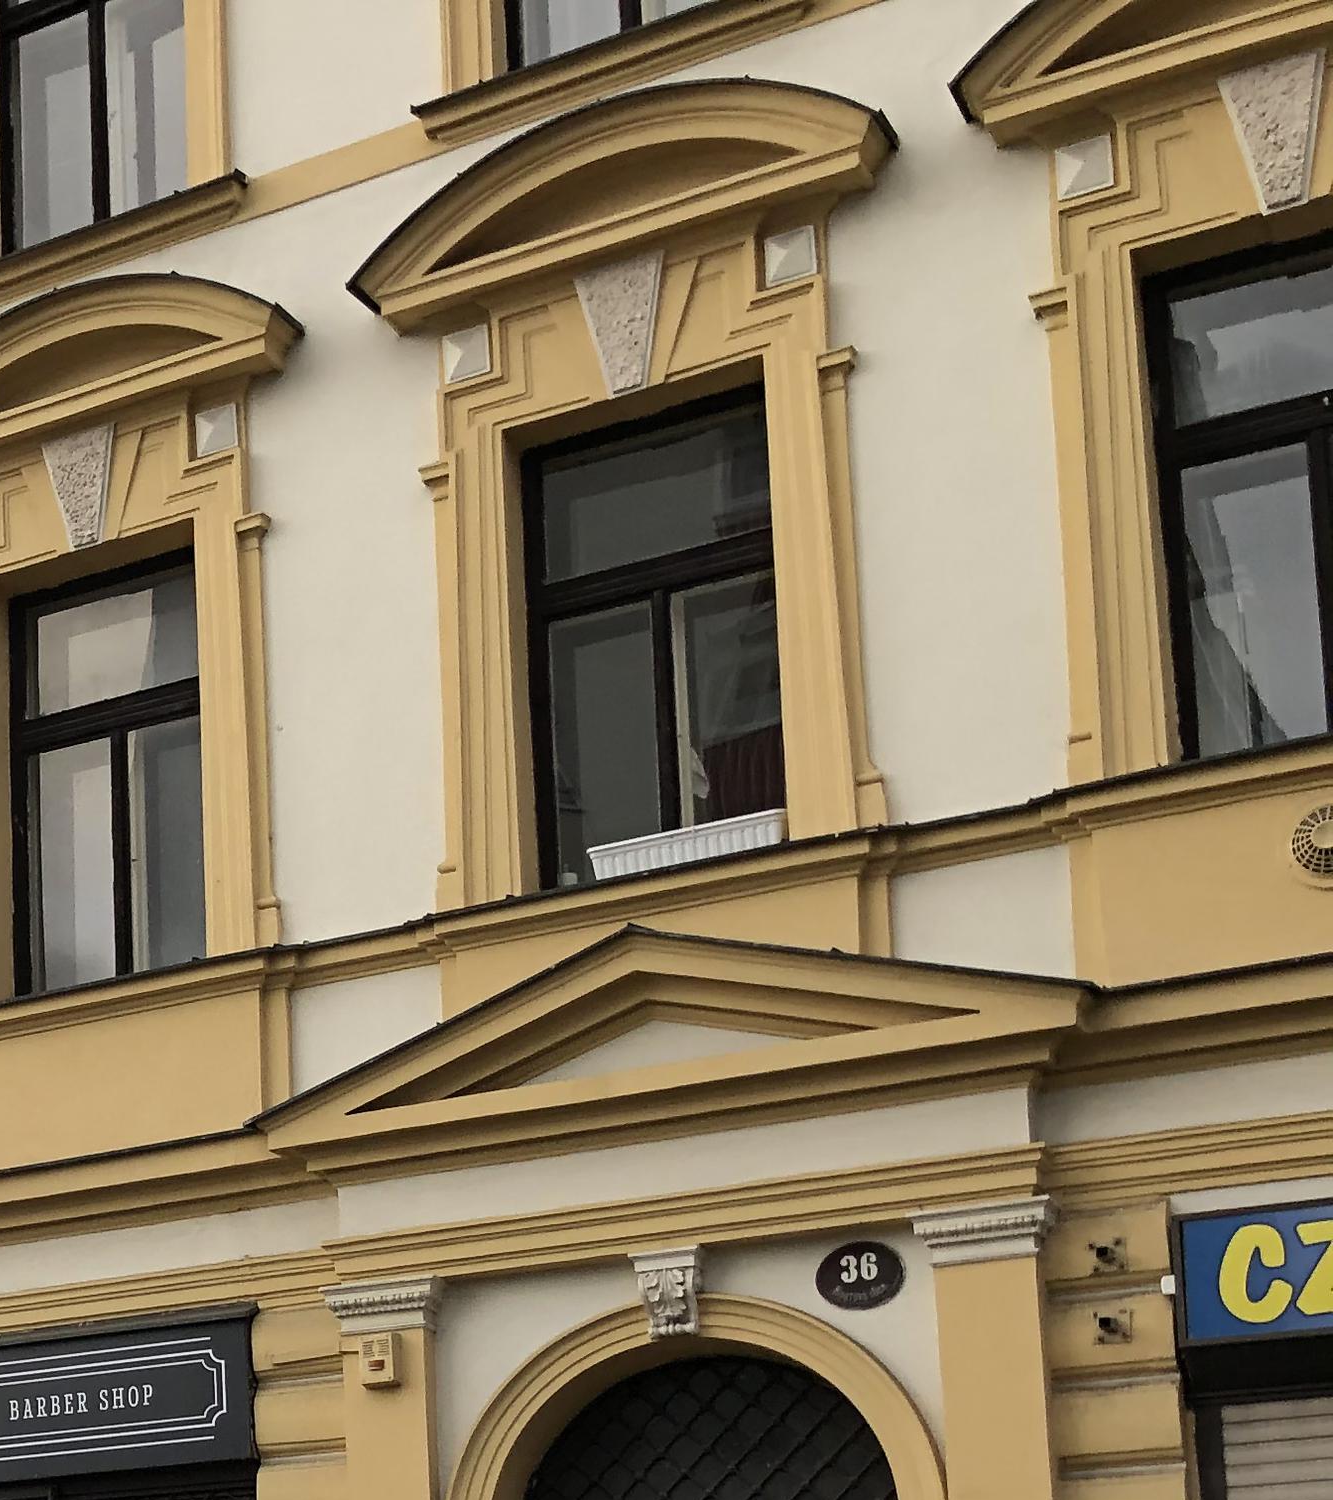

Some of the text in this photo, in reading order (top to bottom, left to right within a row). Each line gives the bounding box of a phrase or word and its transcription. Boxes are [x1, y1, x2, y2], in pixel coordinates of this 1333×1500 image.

[839, 1252, 878, 1283] 36
[9, 1384, 153, 1421] BARBER SHOP
